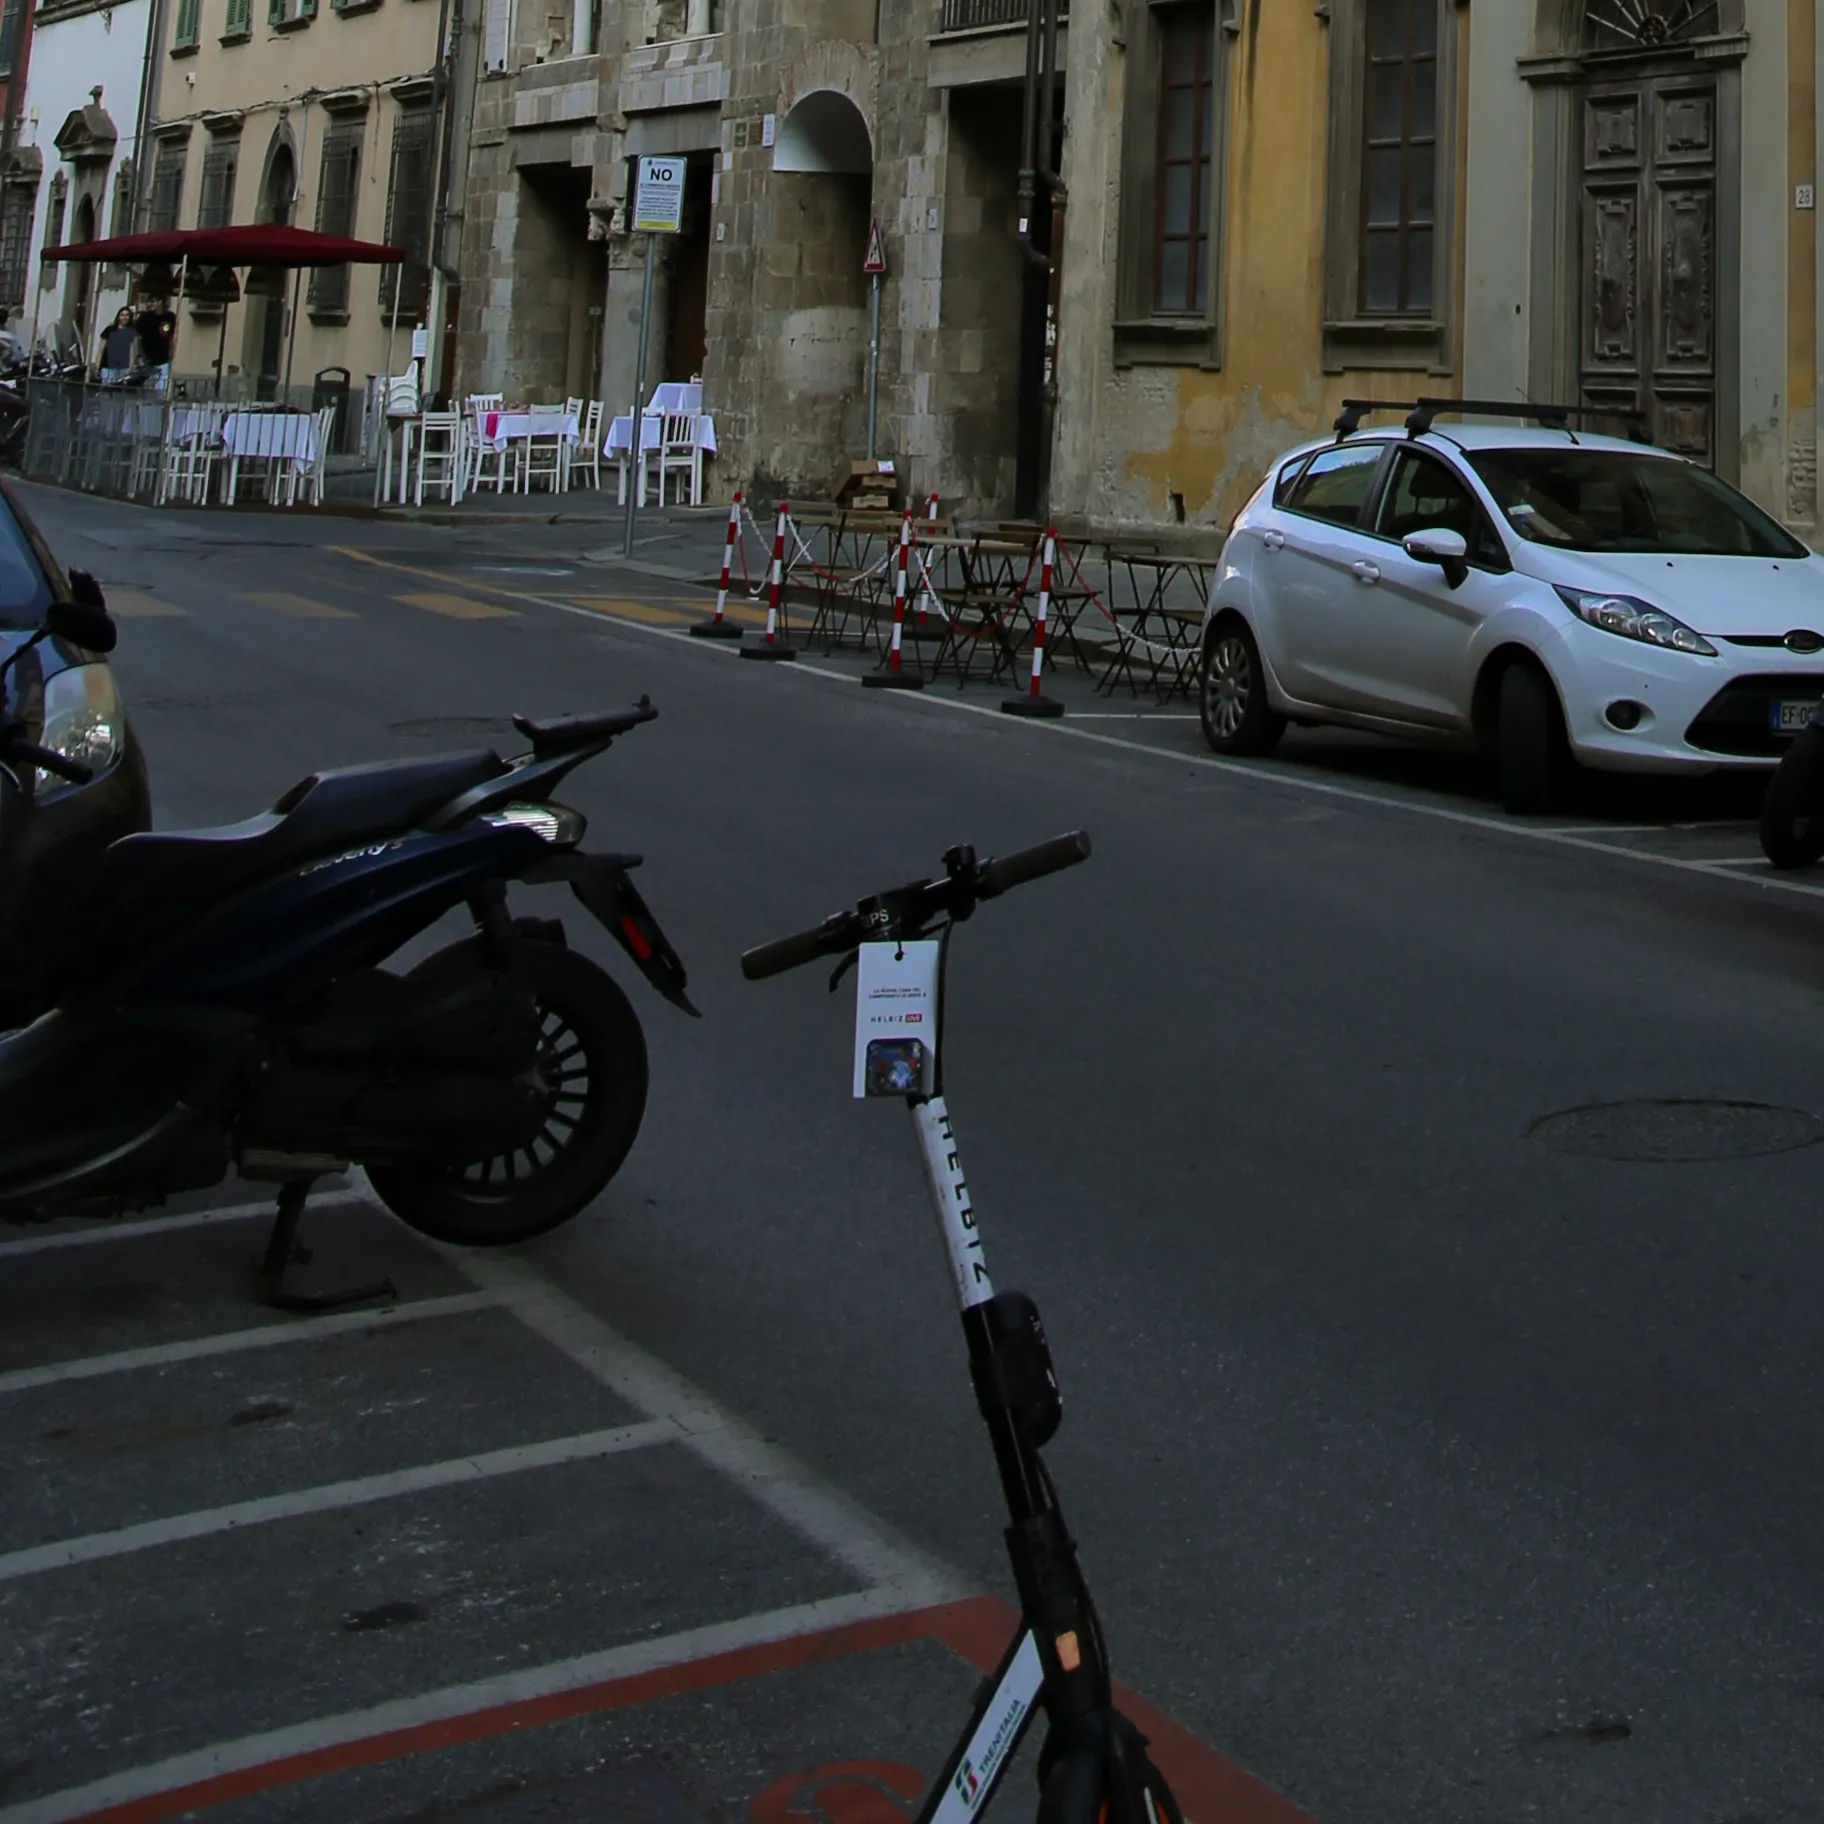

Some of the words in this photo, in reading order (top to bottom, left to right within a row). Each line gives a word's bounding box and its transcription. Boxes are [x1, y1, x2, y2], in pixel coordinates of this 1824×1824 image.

[650, 168, 672, 181] NO
[1798, 189, 1811, 204] 28
[938, 1114, 989, 1284] HELBIZ
[978, 1698, 1021, 1774] TRENITALIA
